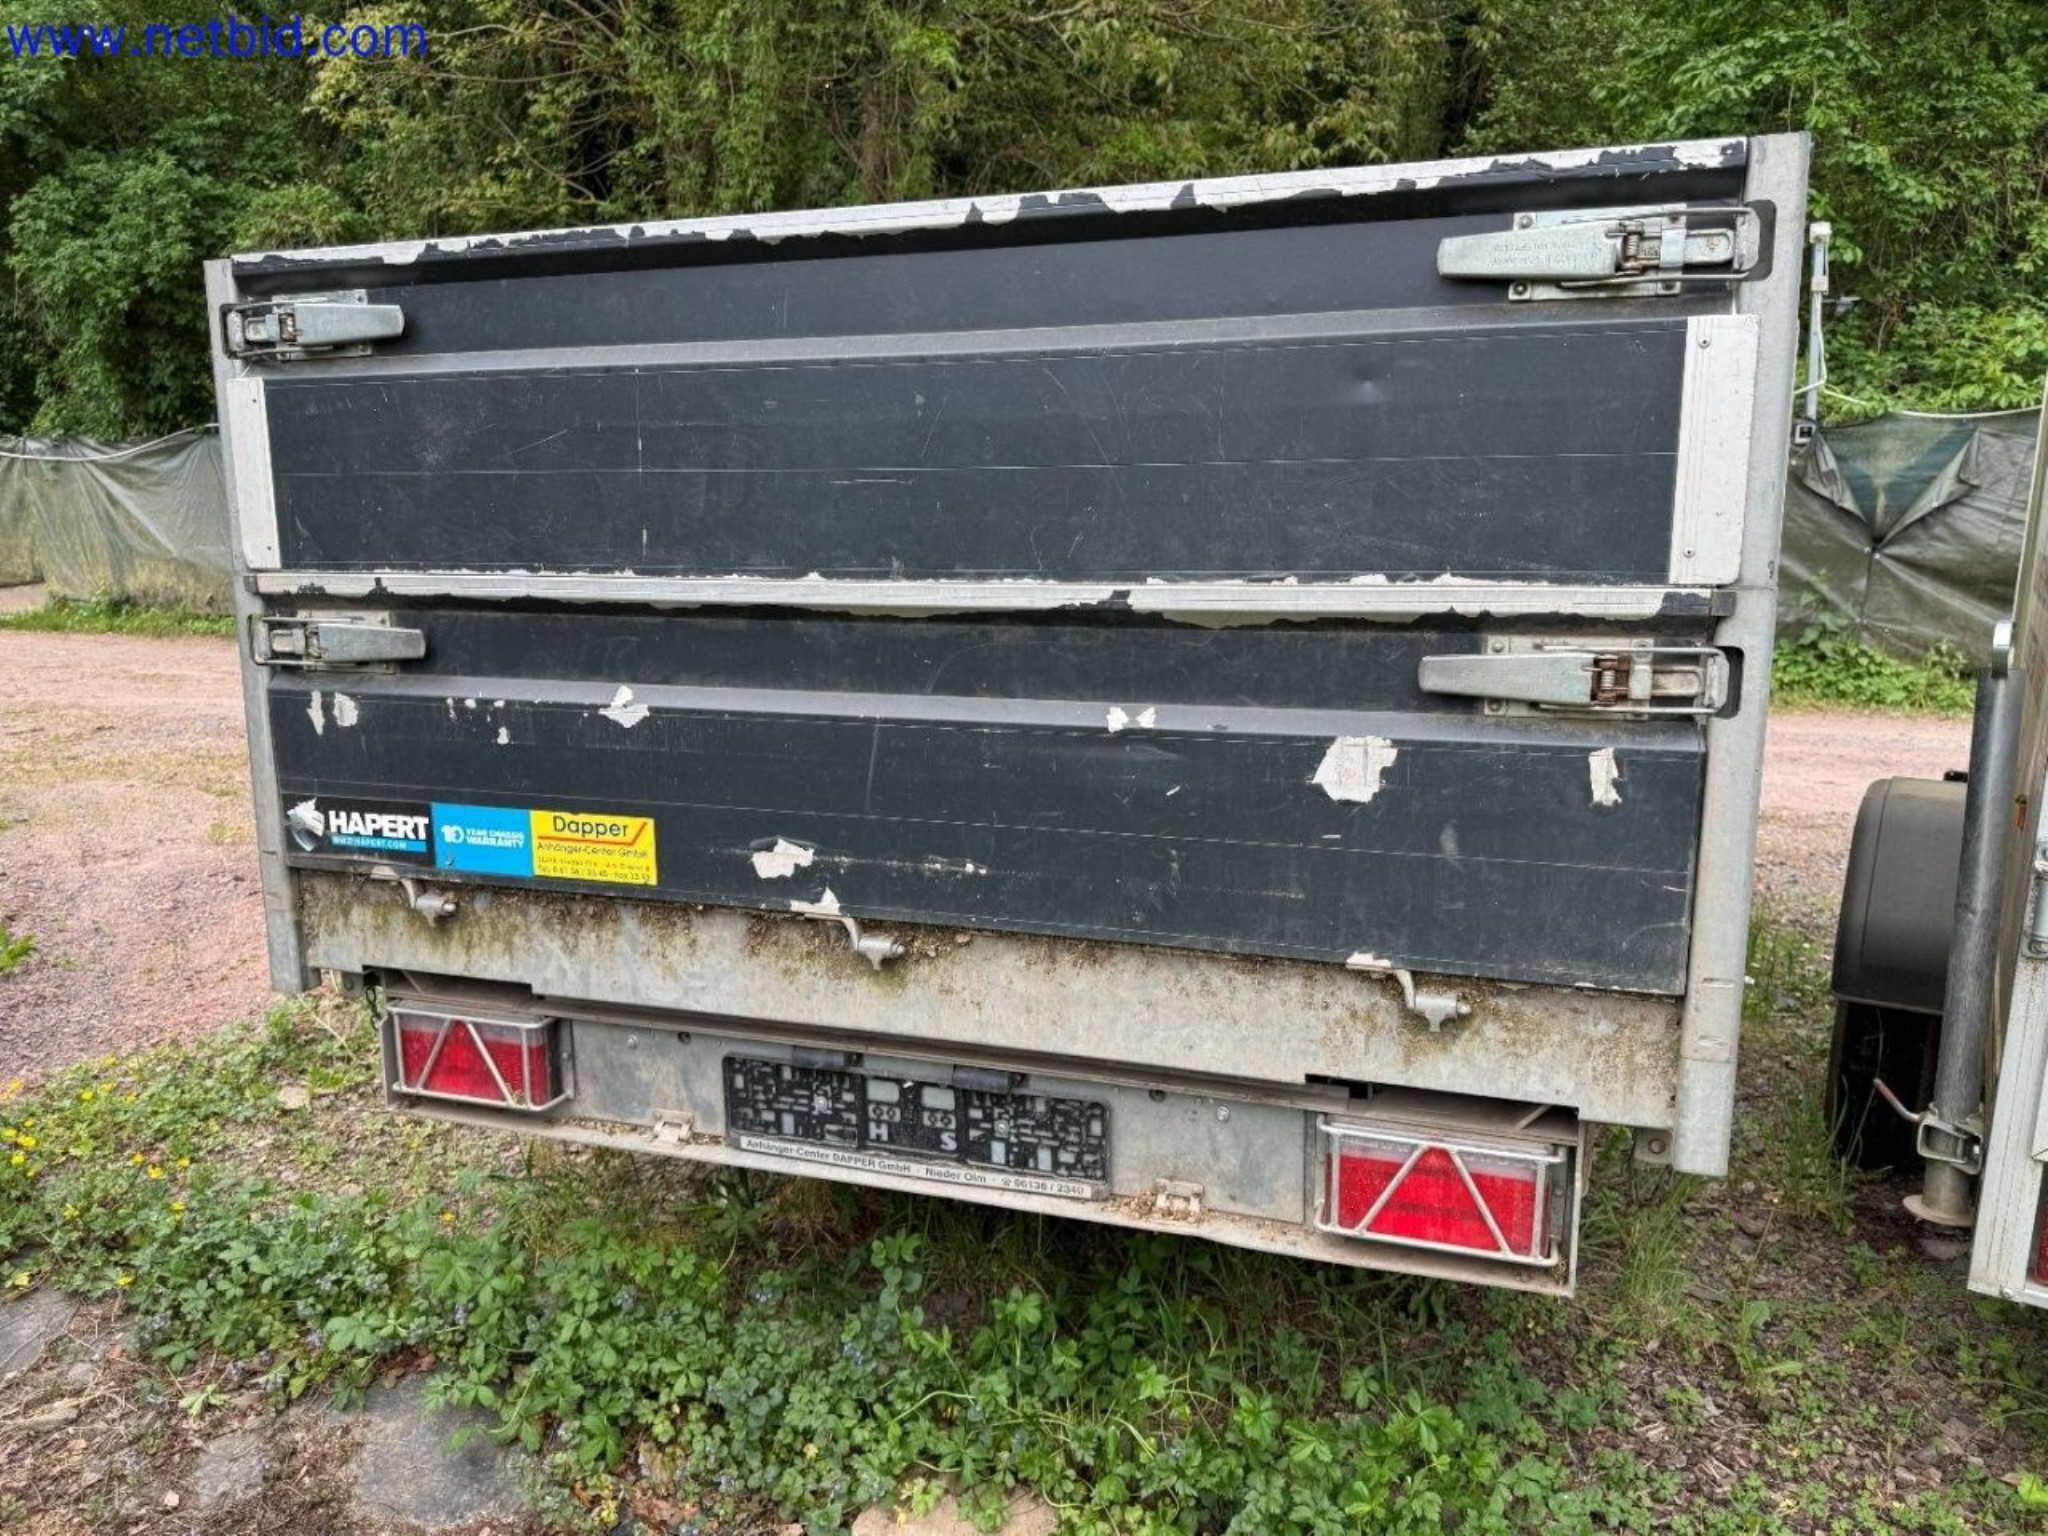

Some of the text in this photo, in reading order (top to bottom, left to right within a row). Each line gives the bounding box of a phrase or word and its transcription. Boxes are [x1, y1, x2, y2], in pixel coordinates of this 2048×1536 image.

[328, 810, 429, 840] HAPERT
[441, 825, 465, 844] 10
[553, 816, 629, 838] Dapper
[467, 836, 524, 848] WARRANTY
[833, 1153, 875, 1168] DAPPER
[878, 1161, 911, 1173] GmbH
[925, 1167, 961, 1180] Nieder
[964, 1172, 987, 1183] Olm
